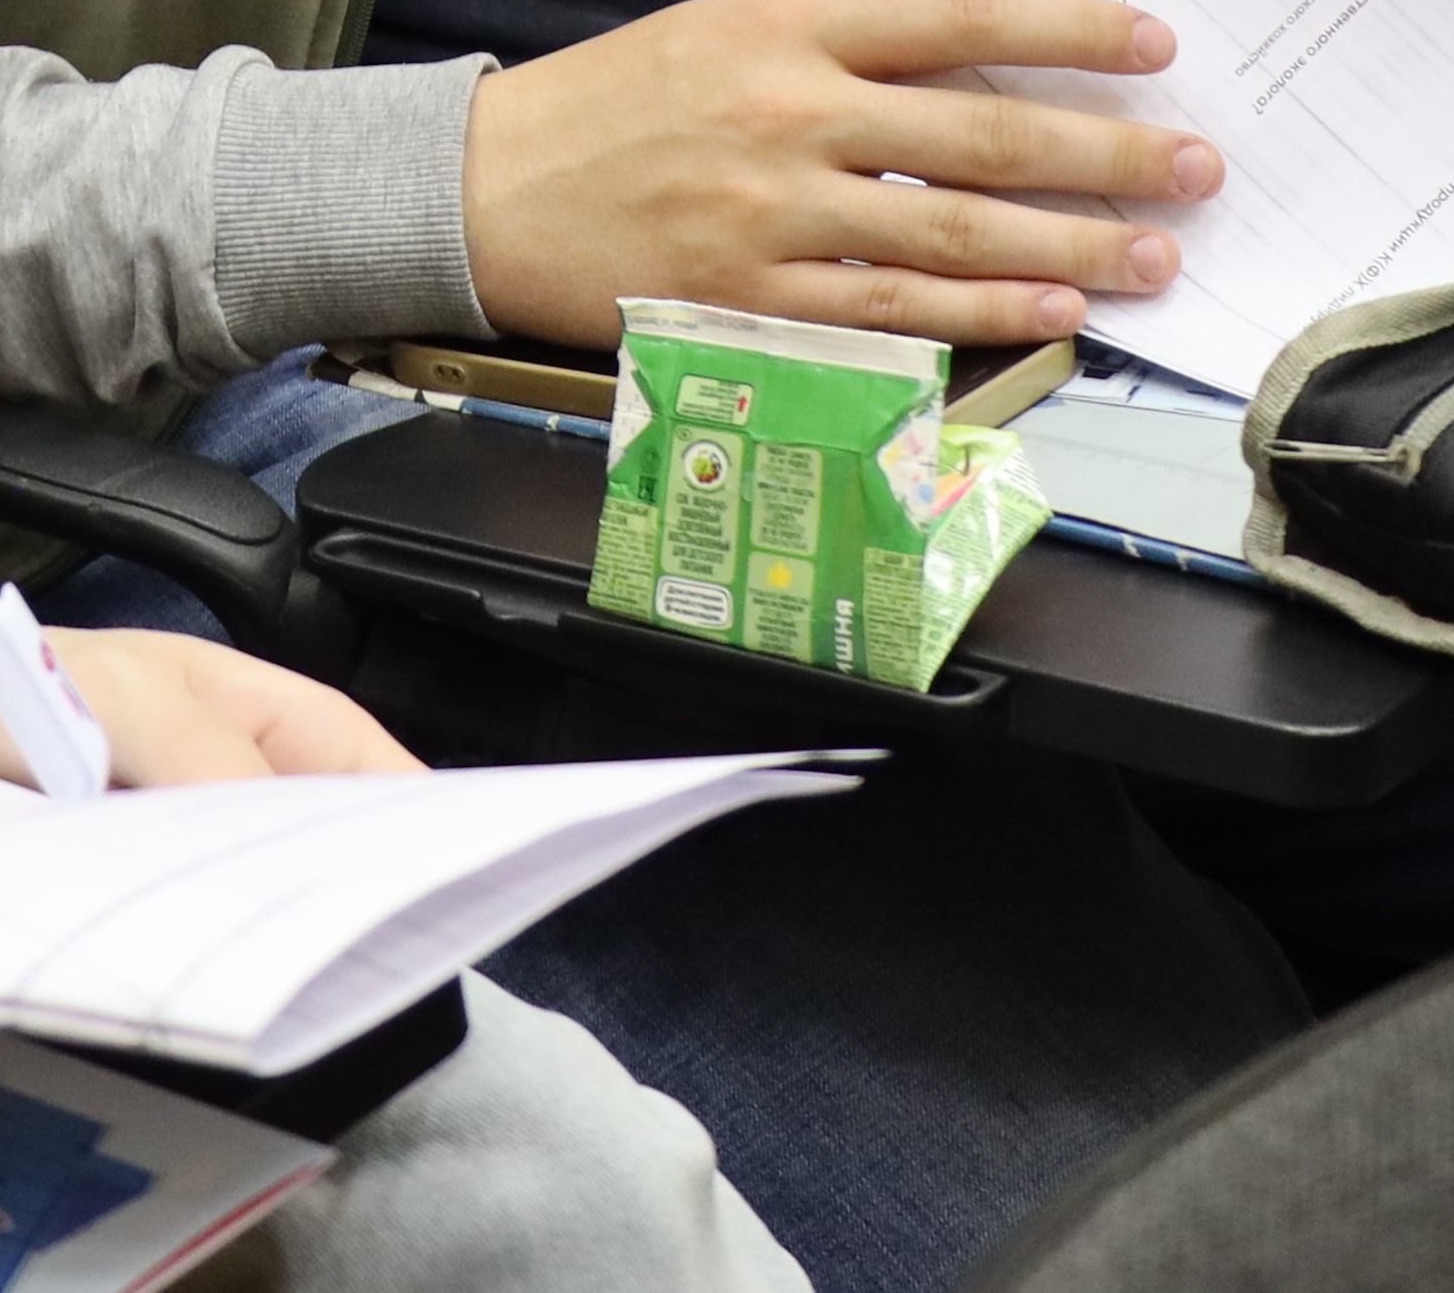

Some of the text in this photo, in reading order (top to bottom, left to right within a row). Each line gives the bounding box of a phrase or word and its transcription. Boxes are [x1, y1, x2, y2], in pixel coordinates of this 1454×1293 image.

[1233, 22, 1289, 79] хозяйства
[1249, 54, 1309, 116] эколога?
[1352, 250, 1394, 290] К(Ф)Х
